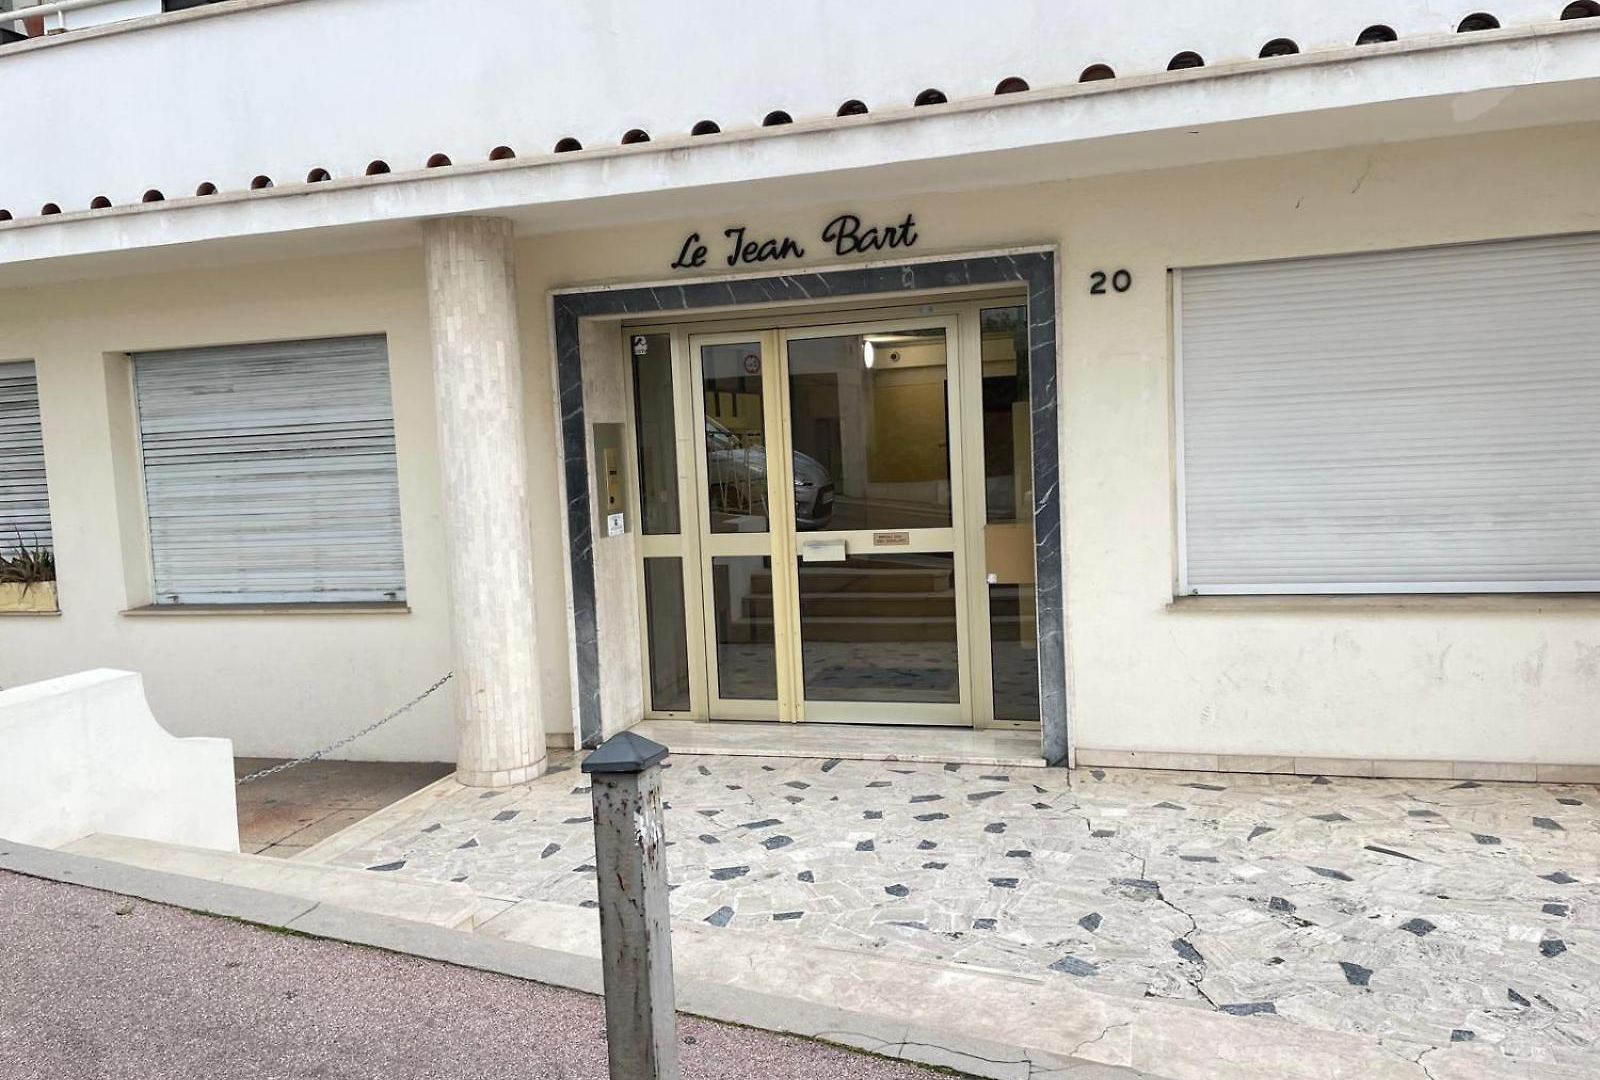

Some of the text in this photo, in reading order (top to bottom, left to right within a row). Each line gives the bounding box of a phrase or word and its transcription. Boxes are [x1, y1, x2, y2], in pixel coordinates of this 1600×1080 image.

[671, 213, 919, 269] Le Jean Bart
[1090, 269, 1132, 295] 20
